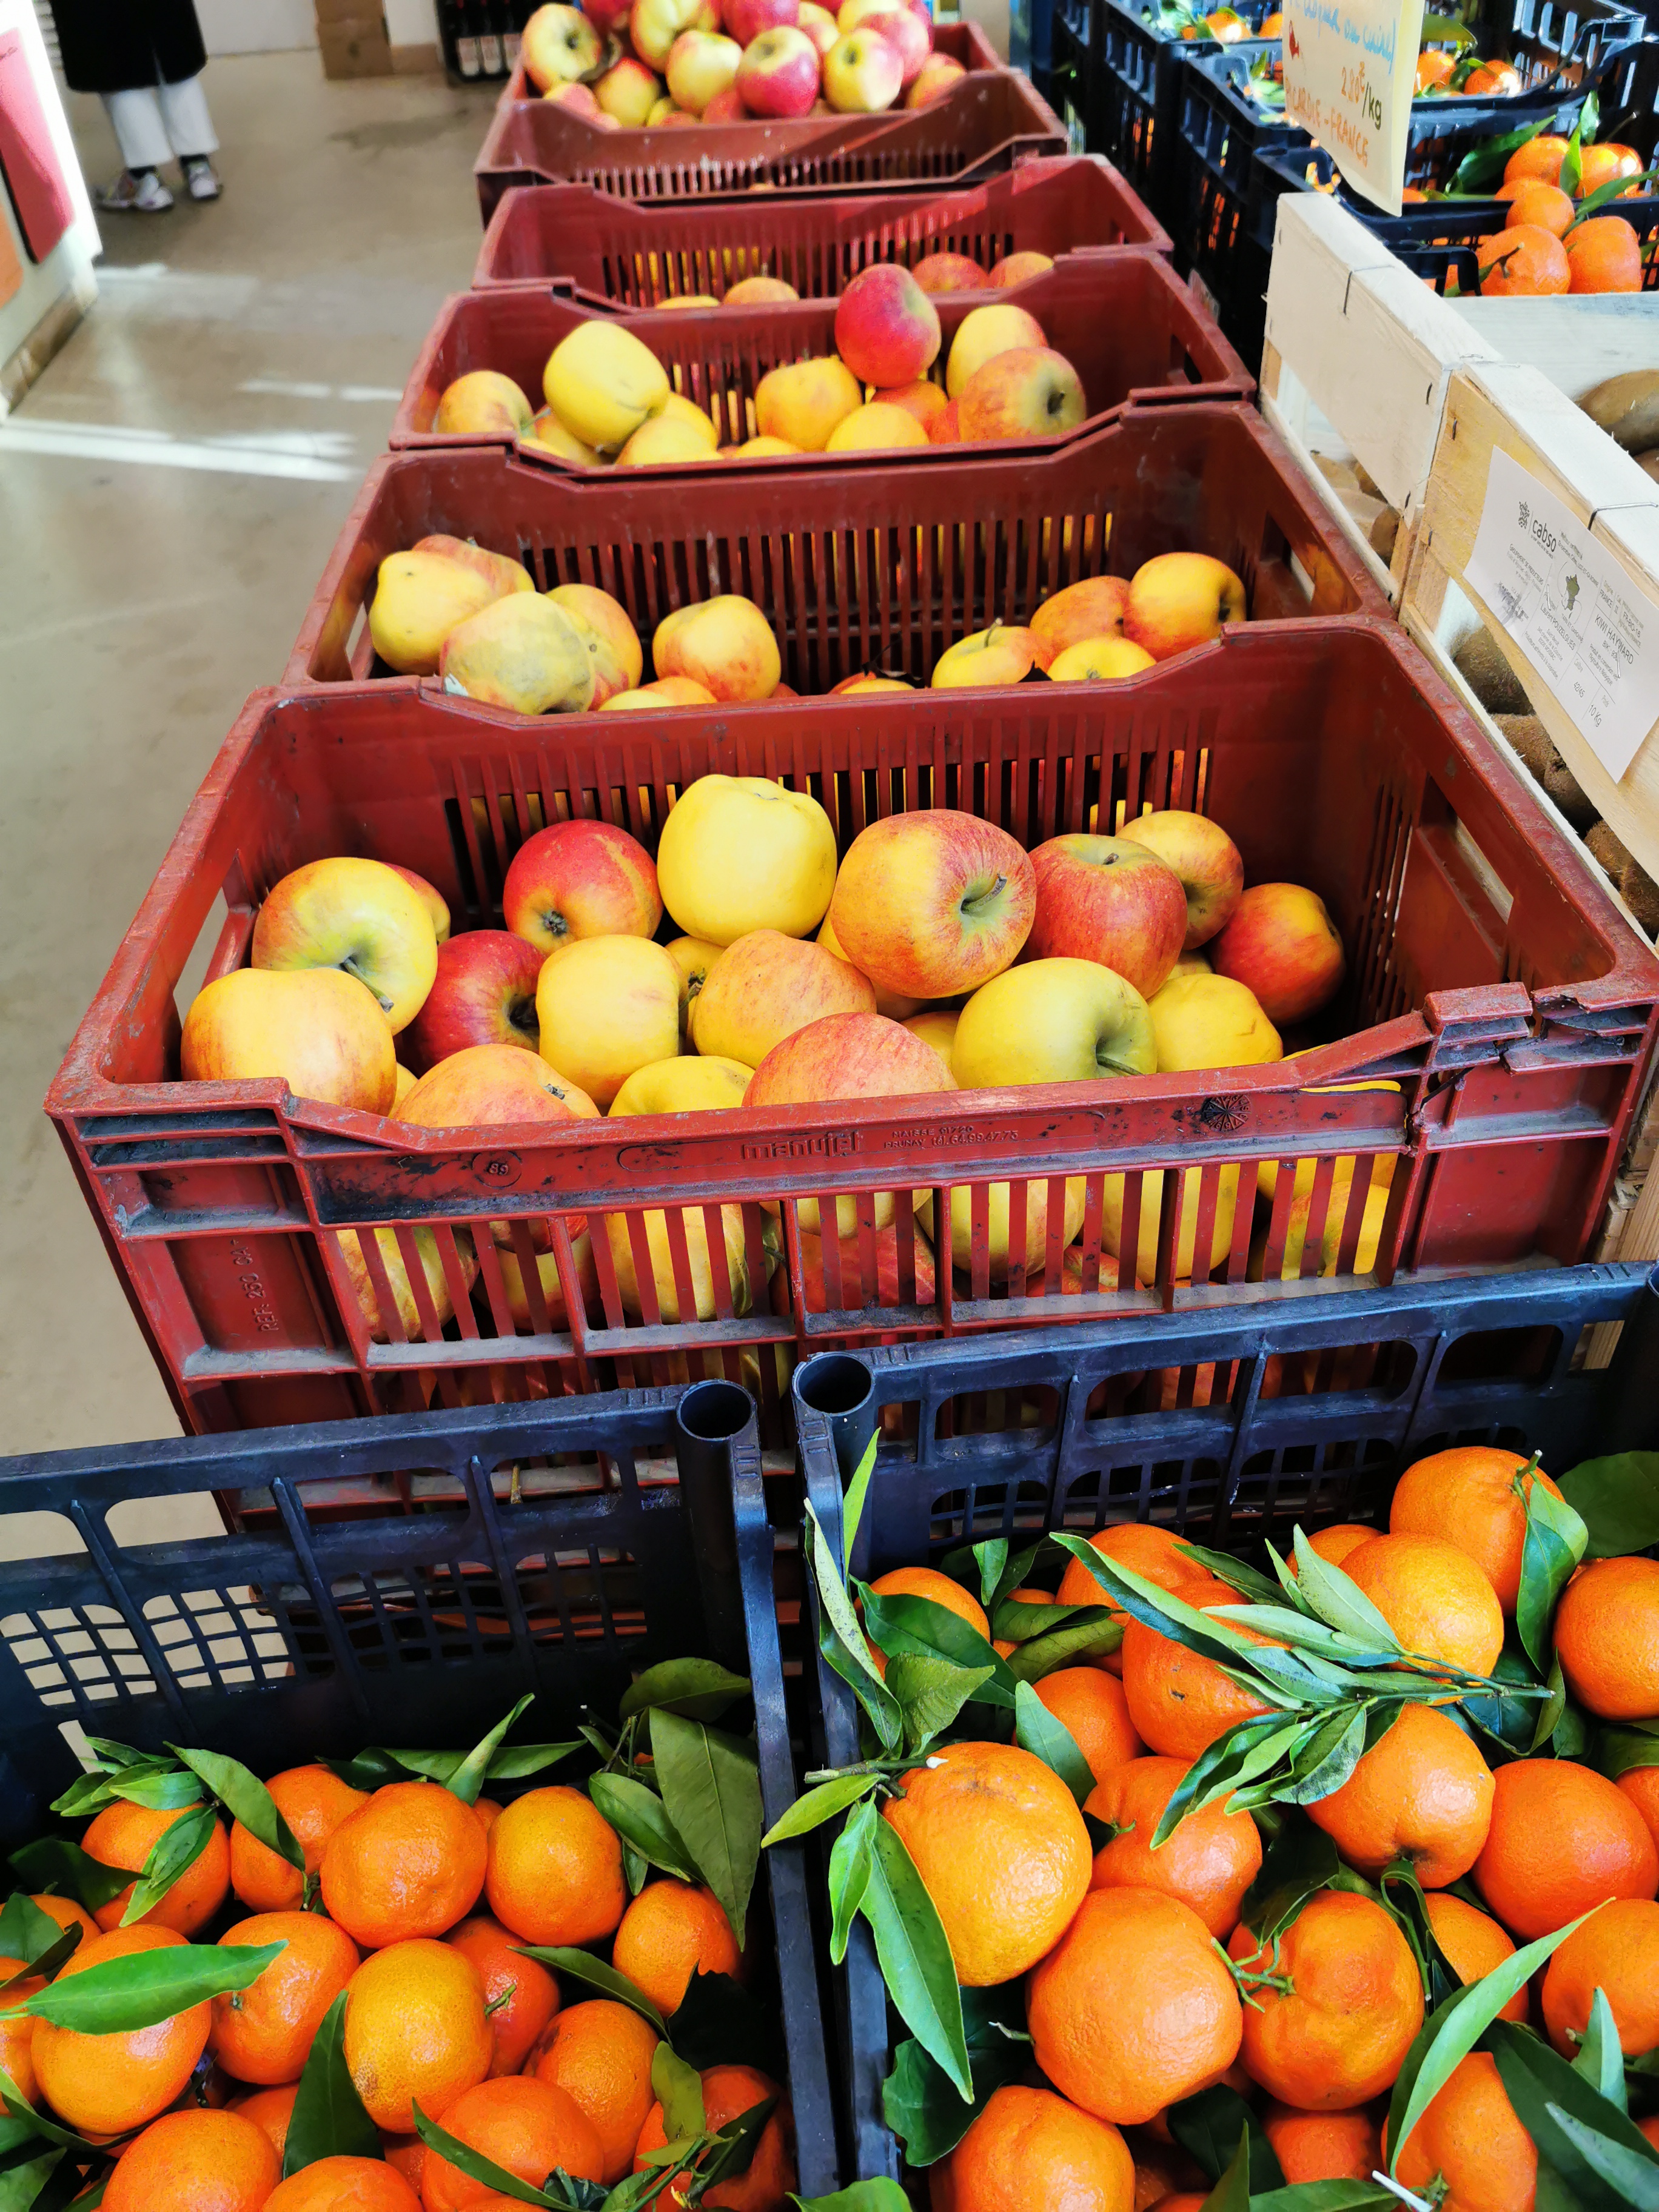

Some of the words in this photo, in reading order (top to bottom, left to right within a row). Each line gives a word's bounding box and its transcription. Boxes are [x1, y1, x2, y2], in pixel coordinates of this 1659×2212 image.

[1330, 107, 1369, 169] FRANCE
[1533, 520, 1557, 552] cabso
[1540, 603, 1553, 623] Laurent
[1594, 613, 1608, 634] KIWI
[1606, 627, 1634, 665] HAYWARD
[1574, 681, 1586, 699] 42/45
[1588, 704, 1597, 717] 10
[1594, 711, 1602, 728] Kg
[939, 1125, 974, 1135] 91720
[883, 1138, 926, 1149] PRUNAY
[488, 1162, 509, 1176] 89
[241, 1272, 267, 1299] 250
[253, 1303, 280, 1331] REF:
